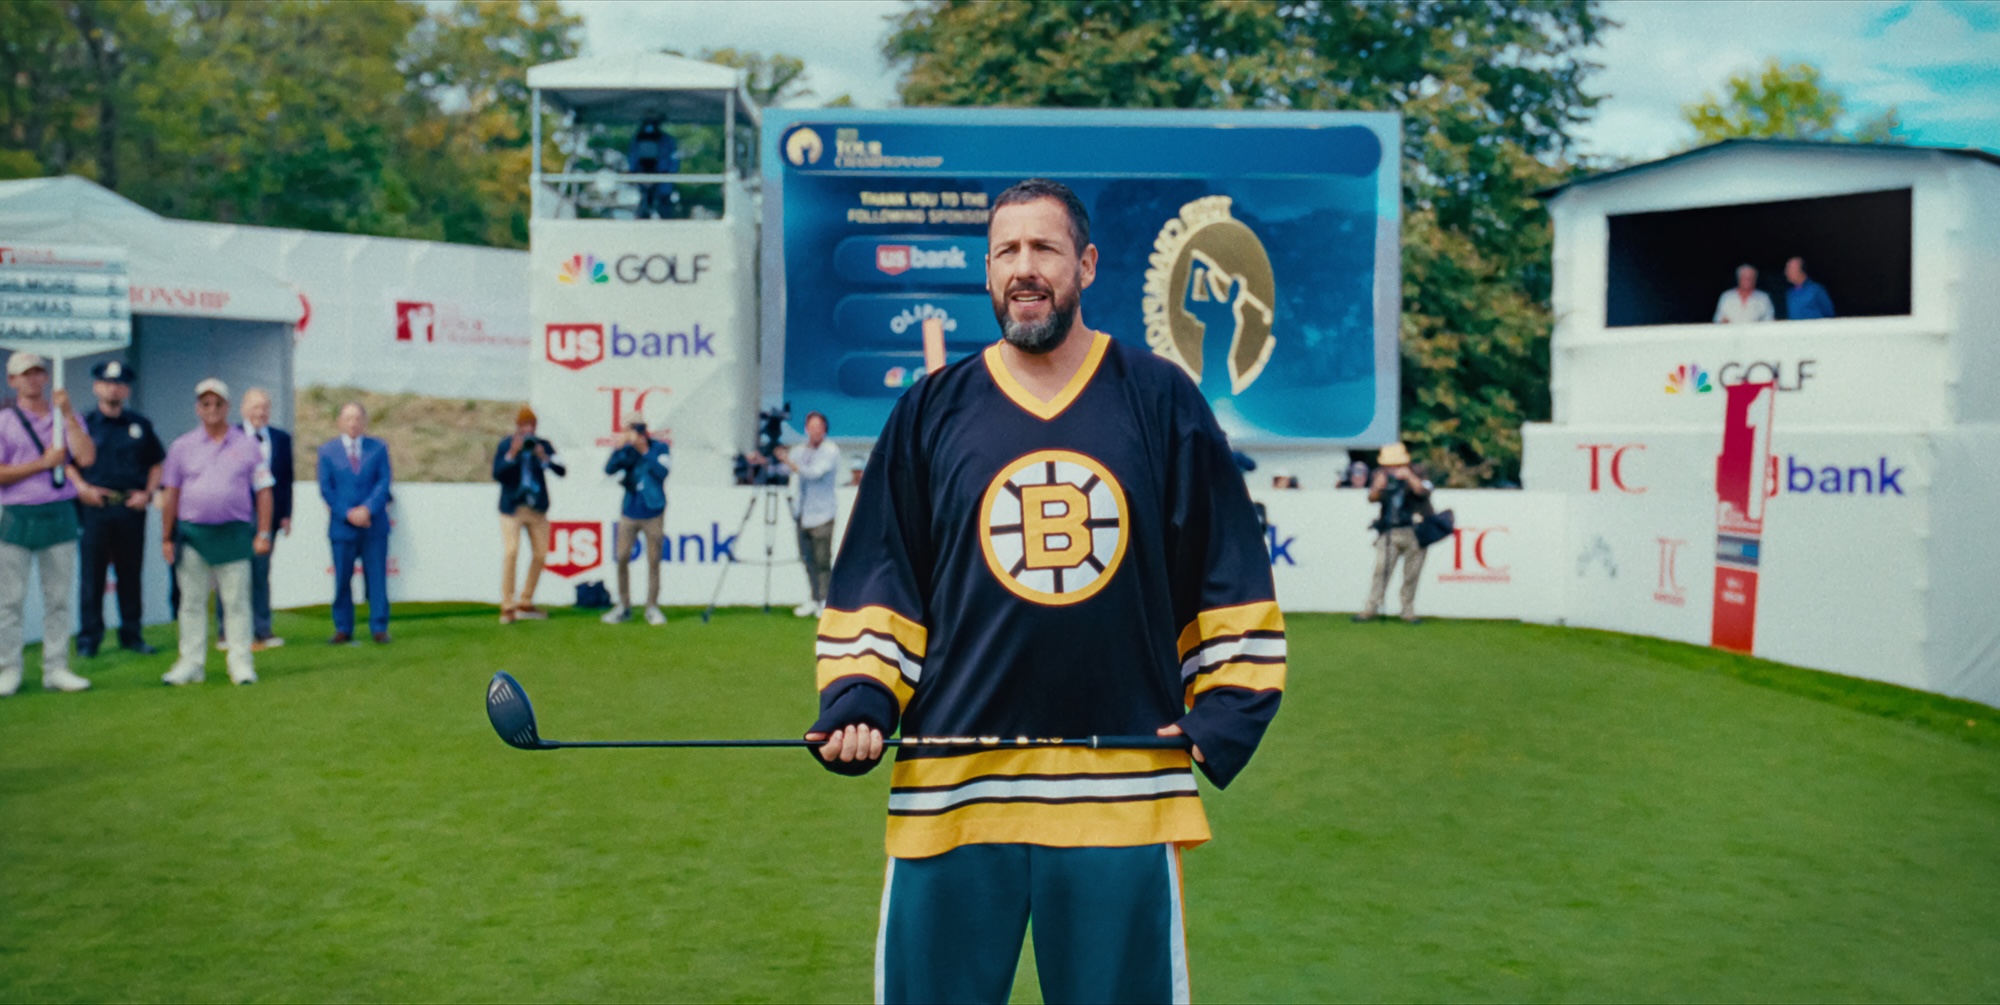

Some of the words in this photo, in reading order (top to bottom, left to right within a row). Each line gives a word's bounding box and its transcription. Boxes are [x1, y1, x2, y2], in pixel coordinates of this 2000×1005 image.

[848, 209, 926, 224] FOLLOWING
[860, 191, 907, 206] THANK
[909, 191, 939, 207] YOU
[941, 191, 960, 207] TO
[962, 191, 988, 207] THE
[614, 254, 711, 285] GOLF
[911, 245, 968, 268] bank
[611, 323, 717, 358] bank
[1576, 443, 1648, 494] TC
[1746, 386, 1774, 521] 1
[1787, 455, 1905, 495] bank
[1019, 482, 1095, 571] B
